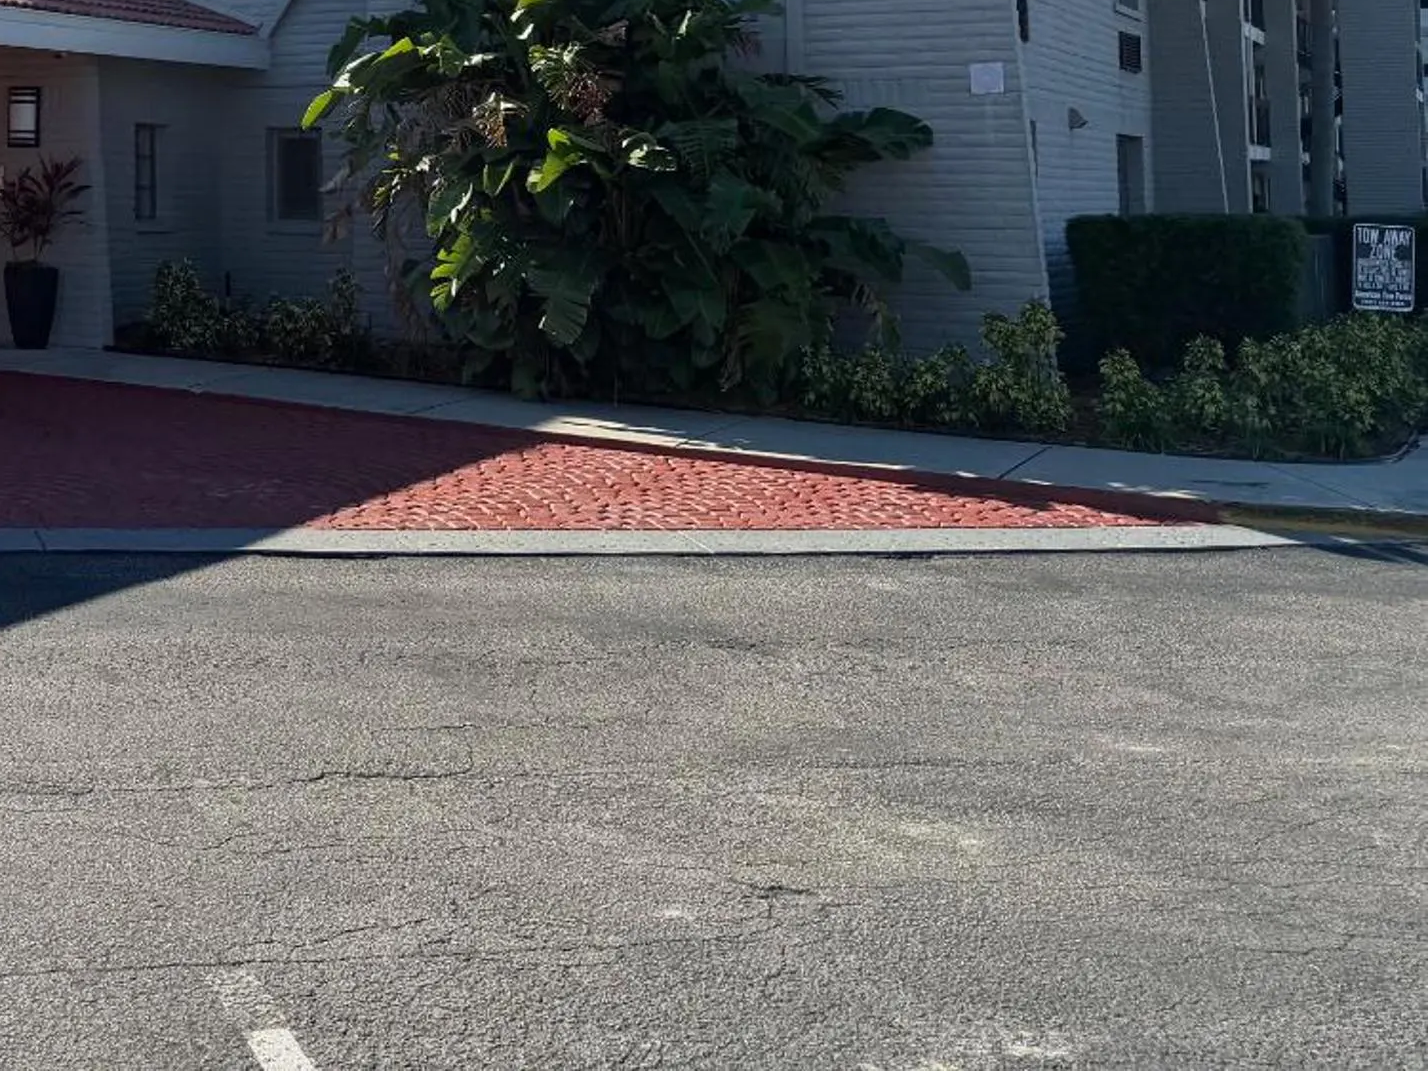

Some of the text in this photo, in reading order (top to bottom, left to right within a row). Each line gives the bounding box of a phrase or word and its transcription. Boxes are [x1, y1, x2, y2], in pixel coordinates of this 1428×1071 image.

[1356, 227, 1412, 247] TOW AWAY
[1370, 243, 1397, 261] ZONE
